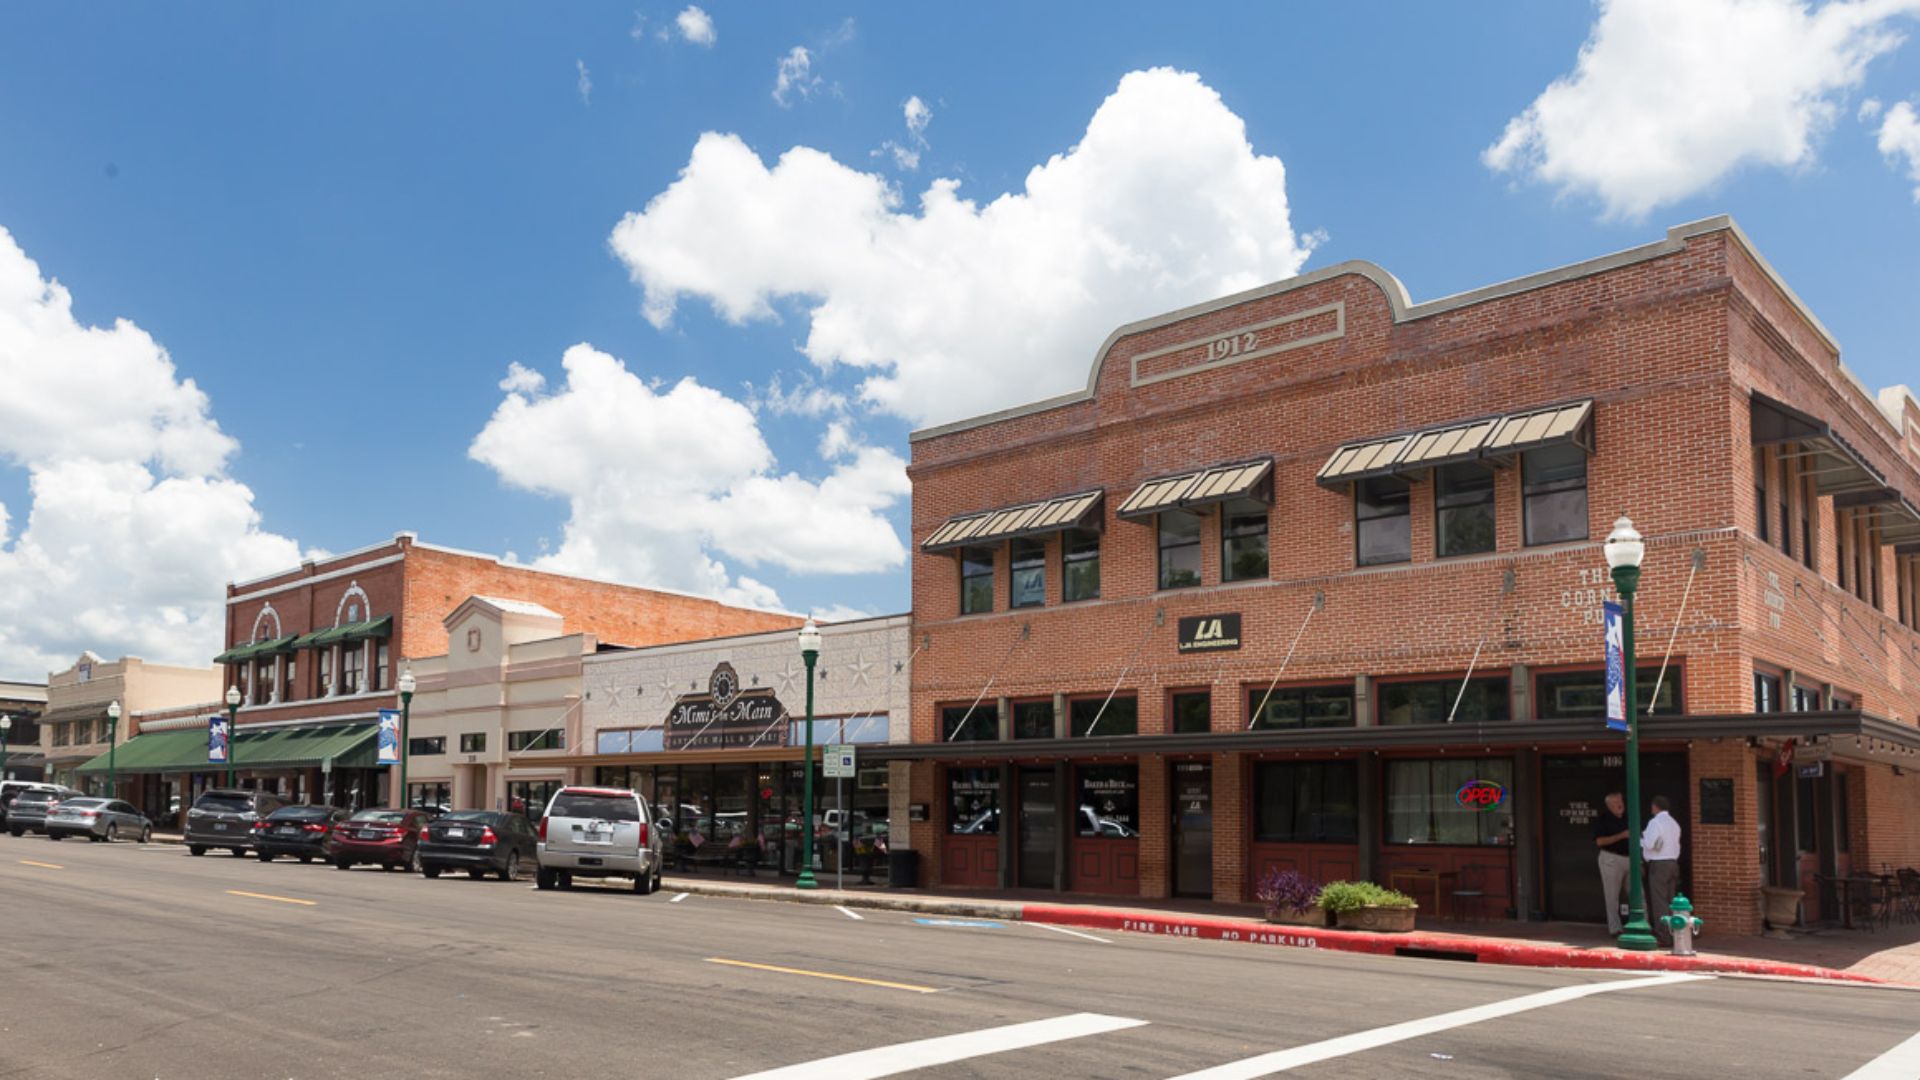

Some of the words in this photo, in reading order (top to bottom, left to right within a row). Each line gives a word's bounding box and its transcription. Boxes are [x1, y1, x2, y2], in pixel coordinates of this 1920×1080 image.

[1207, 332, 1256, 362] 1912
[673, 704, 718, 724] Mimi's
[730, 700, 773, 721] Main
[1459, 787, 1501, 804] OPEN
[1124, 919, 1155, 933] FIRE
[1165, 924, 1199, 937] LANE
[1222, 929, 1240, 941] NO
[1250, 931, 1317, 948] PARKING
